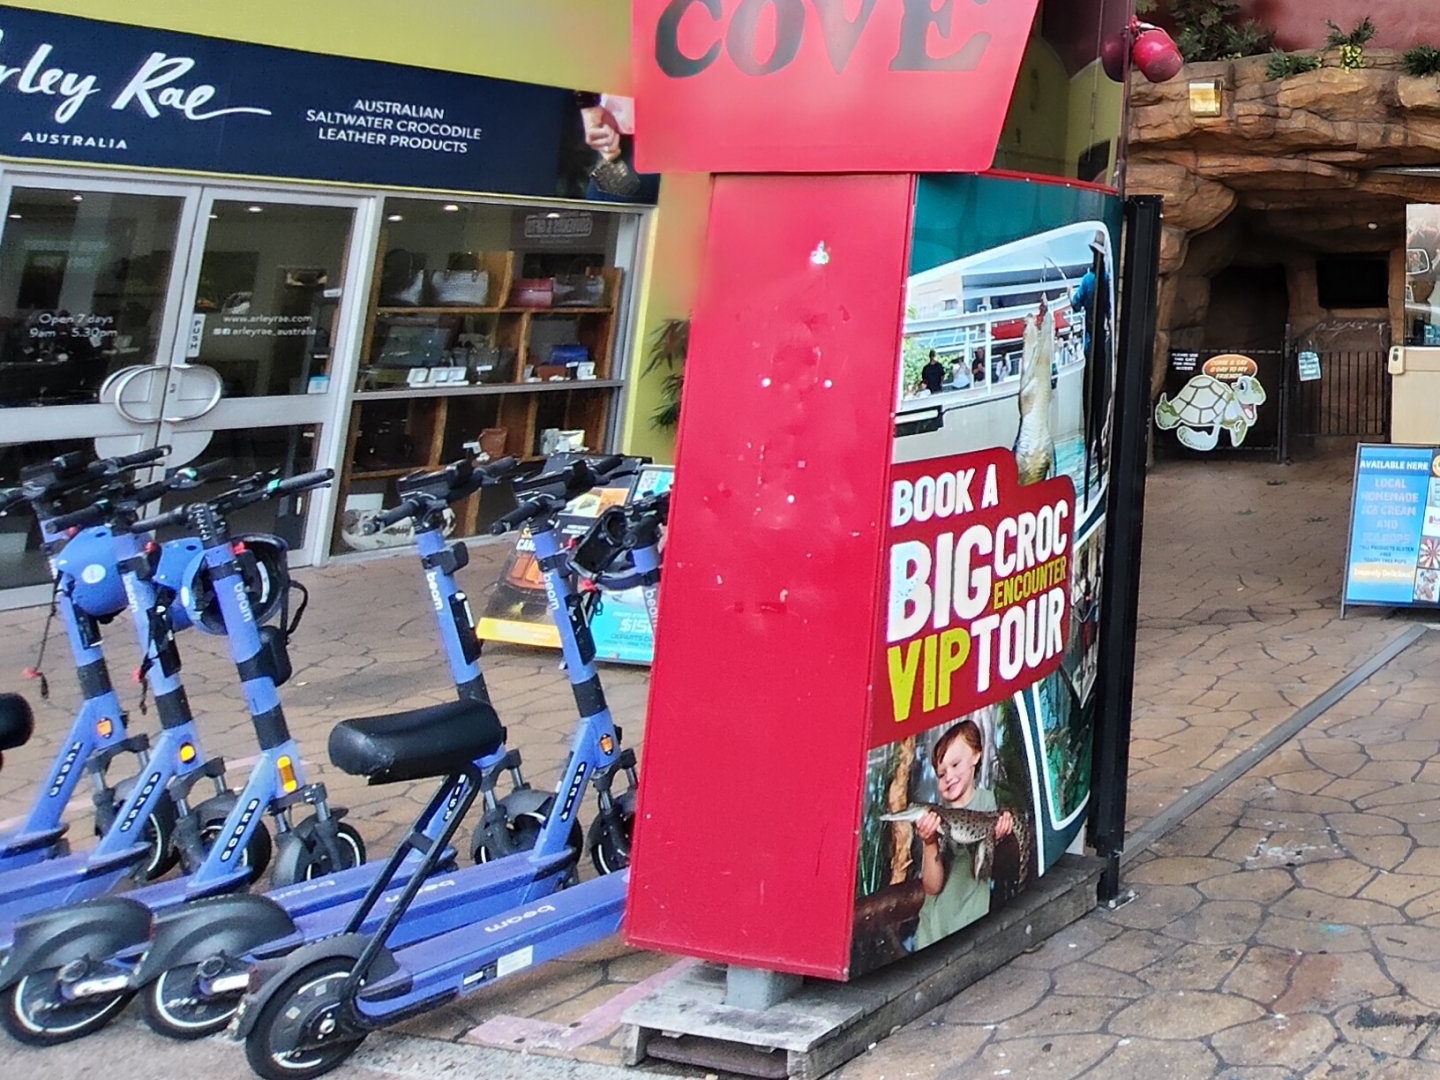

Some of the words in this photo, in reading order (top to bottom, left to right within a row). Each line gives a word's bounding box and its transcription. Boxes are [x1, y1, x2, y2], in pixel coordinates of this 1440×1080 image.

[0, 29, 101, 124] rley
[111, 51, 272, 121] Rae
[306, 109, 394, 130] SALTWATER
[396, 120, 482, 140] CROCODILE
[353, 99, 445, 120] AUSTRALIAN
[21, 131, 128, 150] AUSTRALIA
[318, 127, 386, 146] LEATHER
[389, 134, 468, 154] PRODUCTS
[29, 328, 58, 339] 9am
[71, 327, 118, 340] 5.30pm
[38, 313, 75, 326] Open
[77, 313, 85, 324] 7
[88, 313, 114, 326] days
[188, 319, 202, 351] PUSH
[223, 314, 313, 325] www.arleyrae.com
[1359, 460, 1405, 470] AVAILABLE
[1406, 461, 1429, 470] HERE
[891, 468, 975, 527] BOOK
[981, 463, 999, 510] A
[1361, 492, 1419, 503] HOMEMADE
[1375, 478, 1406, 489] LOCAL
[1376, 520, 1399, 530] AND
[1381, 506, 1417, 517] CREAM
[887, 524, 993, 642] BIG
[994, 498, 1069, 578] CROC
[993, 555, 1067, 610] ENCOUNTER
[123, 572, 139, 613] beam
[233, 581, 254, 622] beam
[426, 571, 444, 611] beam
[543, 572, 560, 611] beam
[887, 627, 971, 722] VIP
[971, 587, 1065, 693] TOUR
[484, 903, 556, 934] beam
